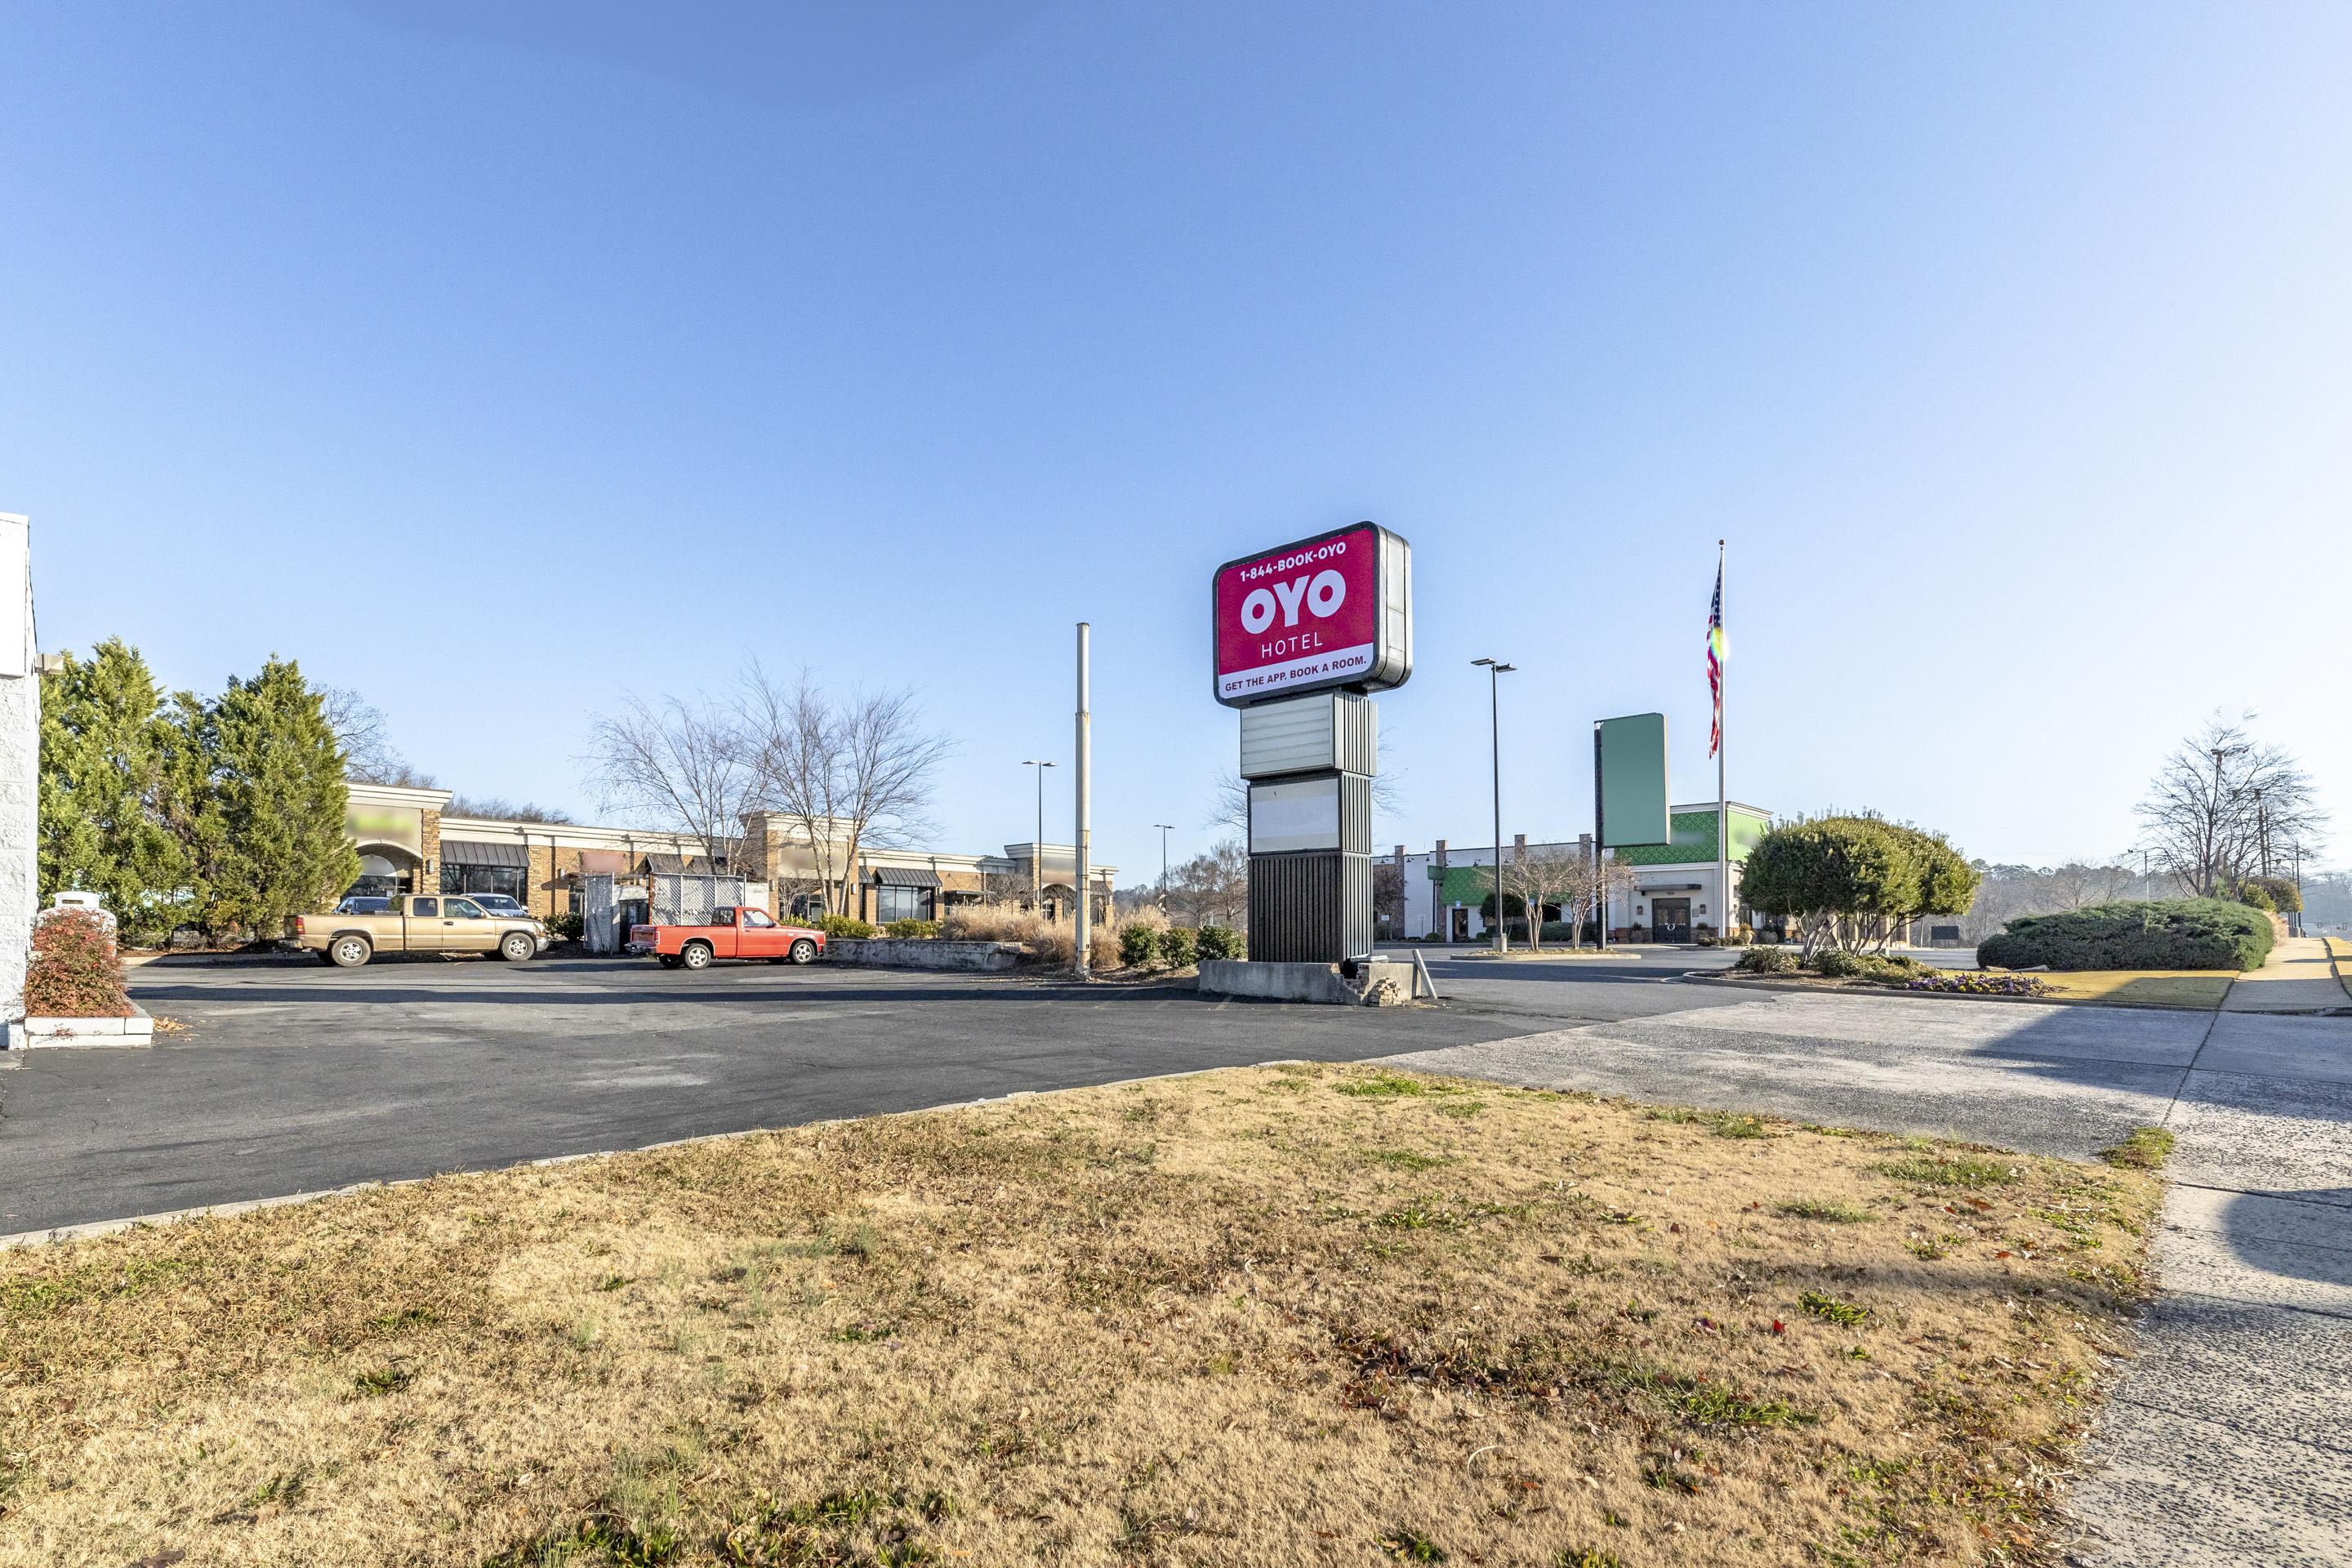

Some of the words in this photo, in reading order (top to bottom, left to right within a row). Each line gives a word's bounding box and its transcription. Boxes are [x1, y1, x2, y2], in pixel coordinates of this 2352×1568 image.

[1240, 541, 1346, 581] 1-844-BOOK-OYO
[1241, 569, 1346, 634] OYO
[1262, 632, 1323, 658] HOTEL
[1225, 680, 1243, 691] GET
[1245, 676, 1264, 688] THE
[1267, 672, 1287, 683] APP.
[1290, 666, 1319, 678] BOOK
[1322, 663, 1329, 671] A
[1332, 656, 1366, 670] ROOM.
